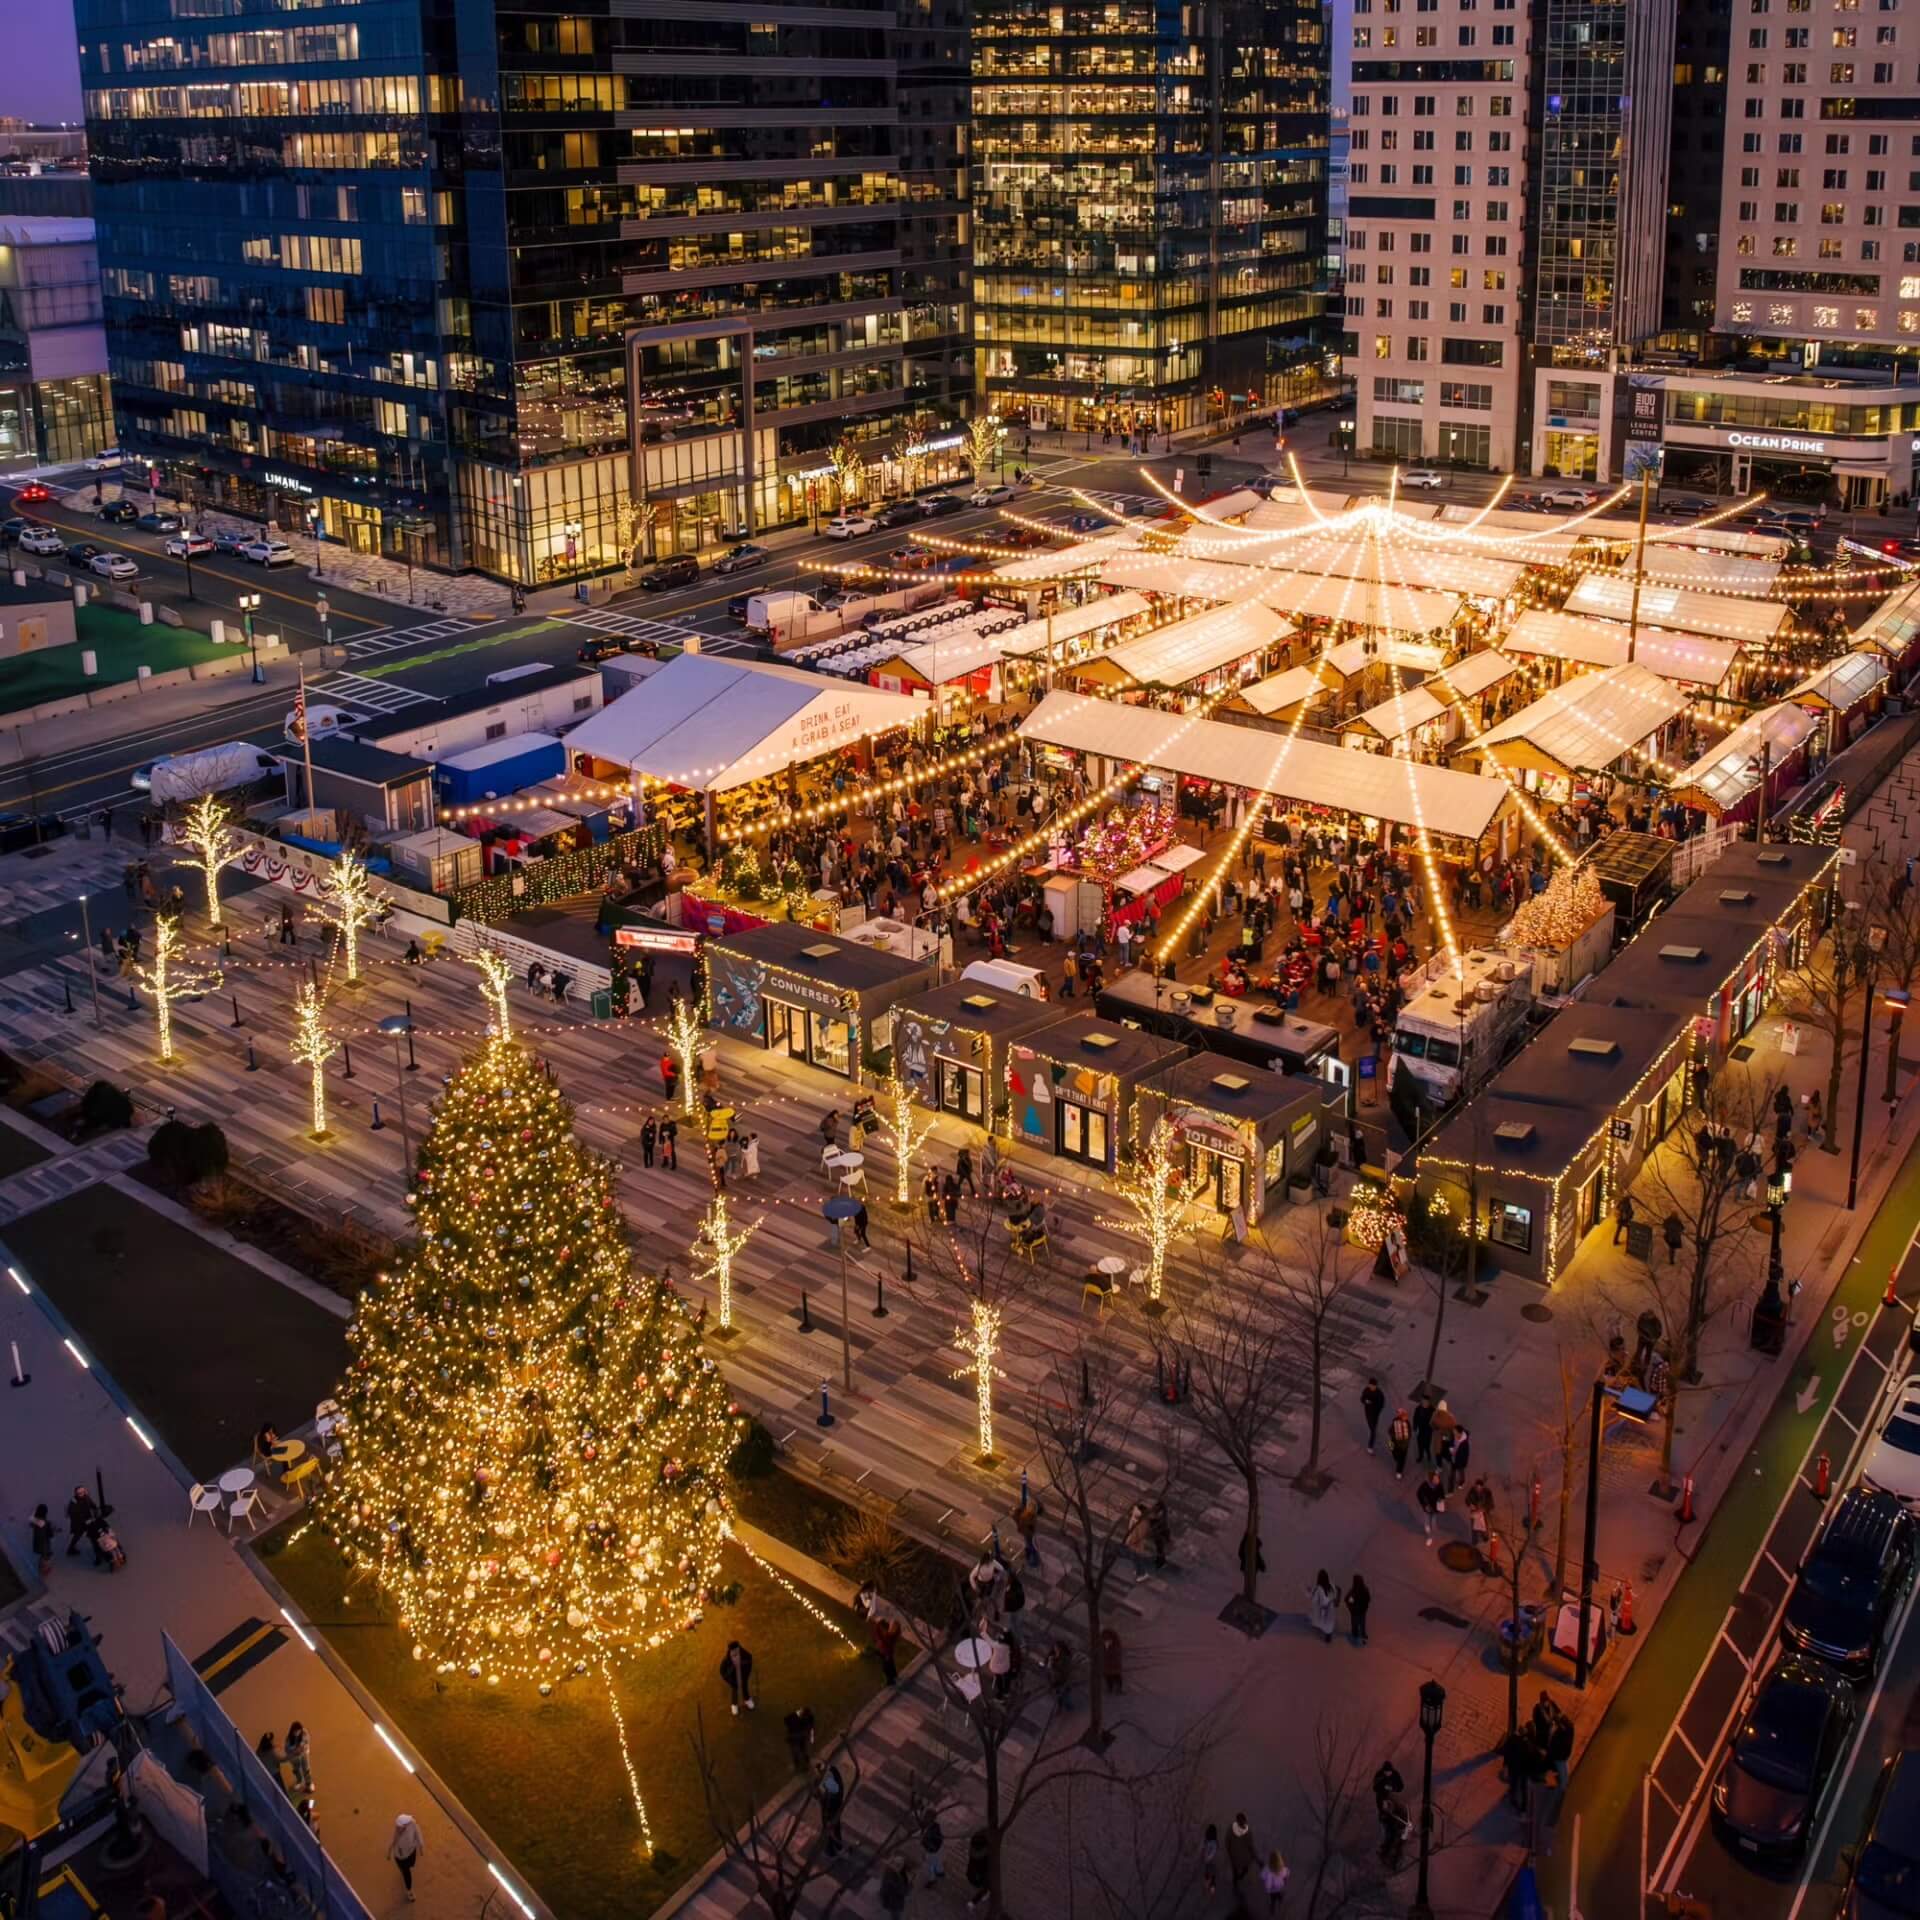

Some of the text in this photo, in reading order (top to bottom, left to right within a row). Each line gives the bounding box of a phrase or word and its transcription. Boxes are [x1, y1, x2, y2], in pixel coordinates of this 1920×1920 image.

[1728, 432, 1825, 452] OCEAN PRIME
[265, 472, 299, 490] LIMANI
[835, 703, 850, 718] EAT
[801, 726, 829, 745] GRAB
[839, 714, 860, 732] SEAT
[770, 976, 830, 1004] CONVERSE
[1184, 1127, 1246, 1157] TOT SHOP
